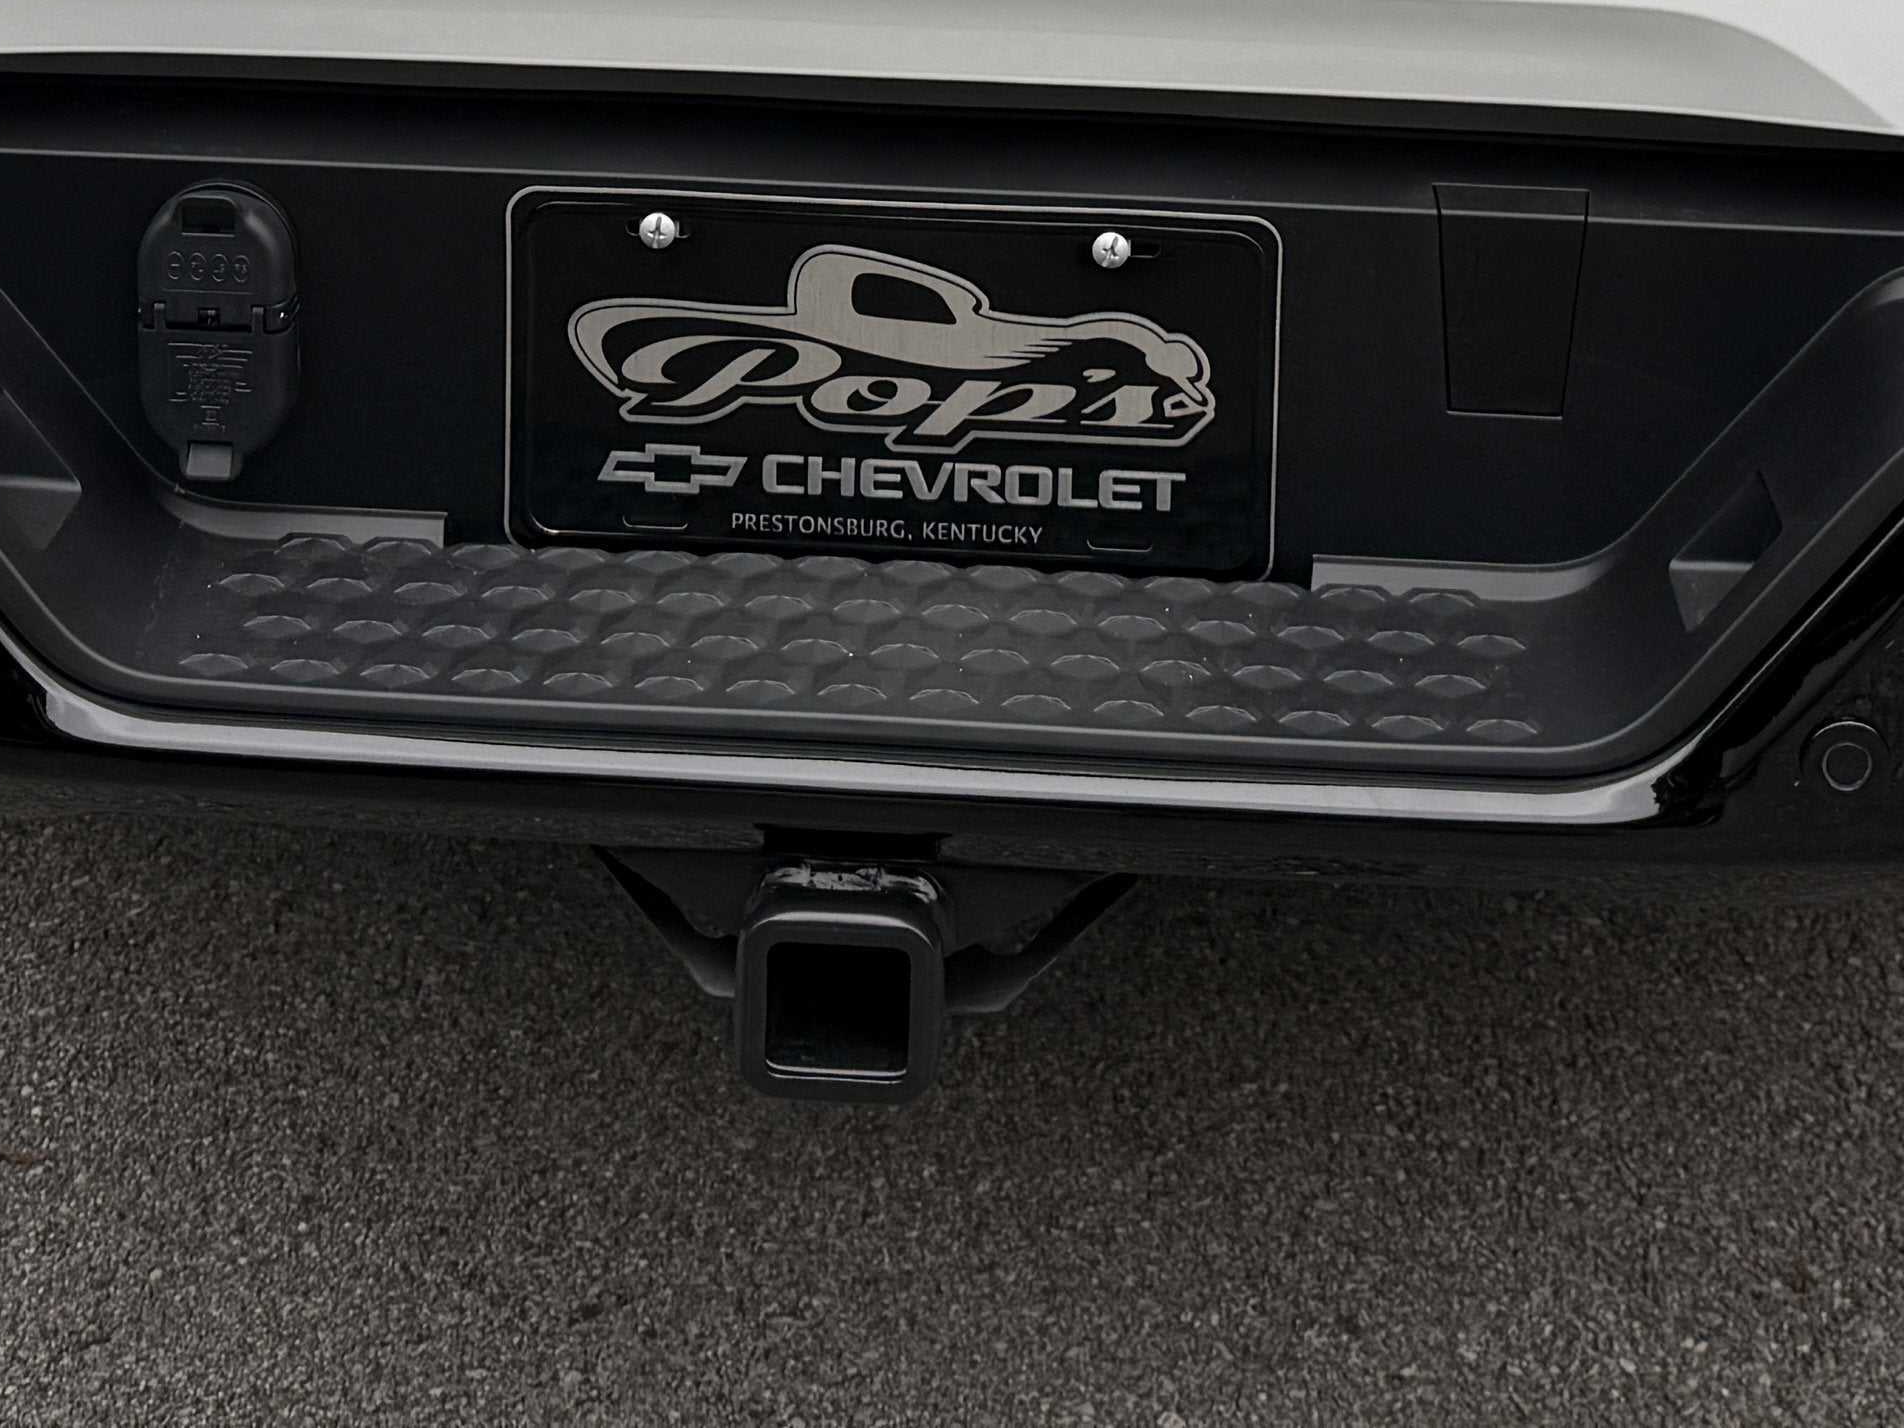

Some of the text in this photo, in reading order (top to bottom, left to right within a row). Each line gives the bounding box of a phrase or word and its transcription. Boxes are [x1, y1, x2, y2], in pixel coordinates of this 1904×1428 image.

[762, 452, 1187, 513] CHEVROLET
[731, 511, 1043, 545] PRESTONSBURG, KENTUCKY
